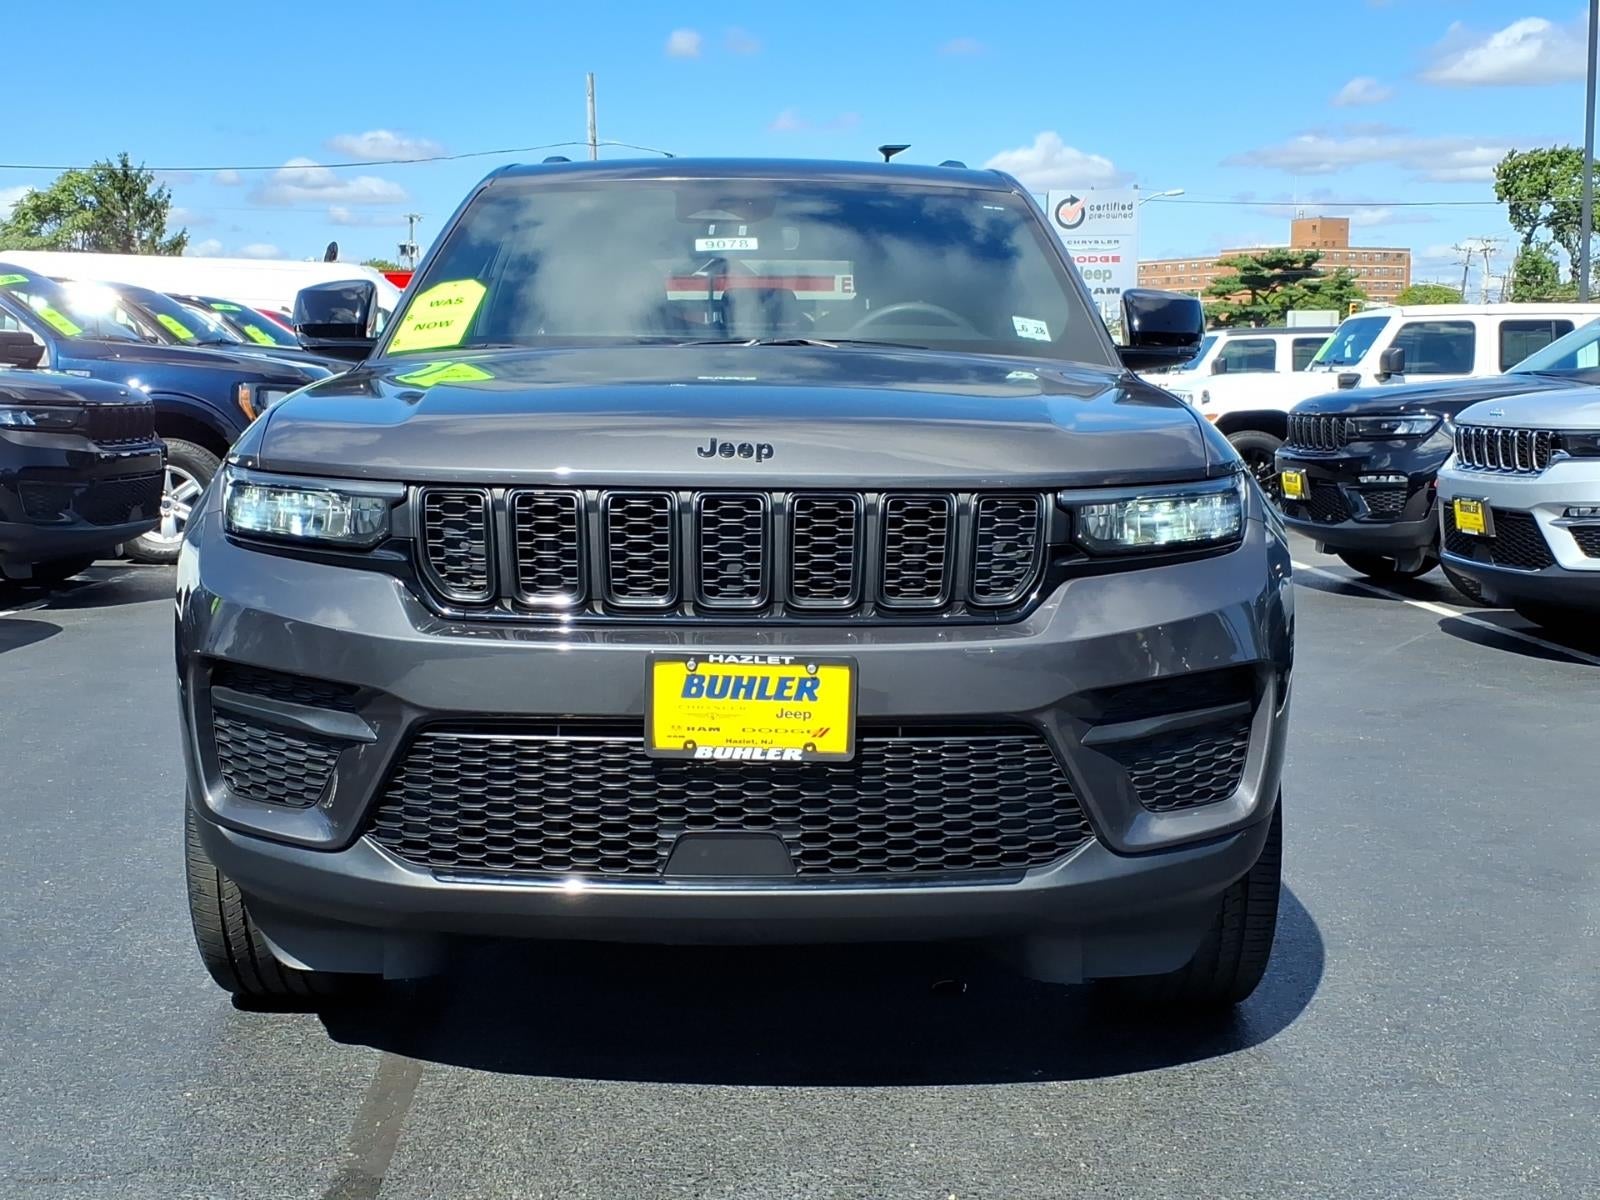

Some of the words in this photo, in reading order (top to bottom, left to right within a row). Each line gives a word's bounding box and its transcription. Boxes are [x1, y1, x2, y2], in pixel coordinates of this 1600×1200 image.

[1089, 201, 1133, 211] certified
[1089, 211, 1133, 221] pre-owned
[704, 239, 749, 249] 9078
[1087, 287, 1121, 295] AM
[429, 296, 465, 309] WAS
[412, 319, 455, 332] NOW
[697, 437, 775, 463] Jeep
[708, 654, 796, 665] HAZLET
[681, 674, 821, 702] BUHLER
[775, 707, 813, 722] Jeep
[693, 746, 804, 761] BUHLER
